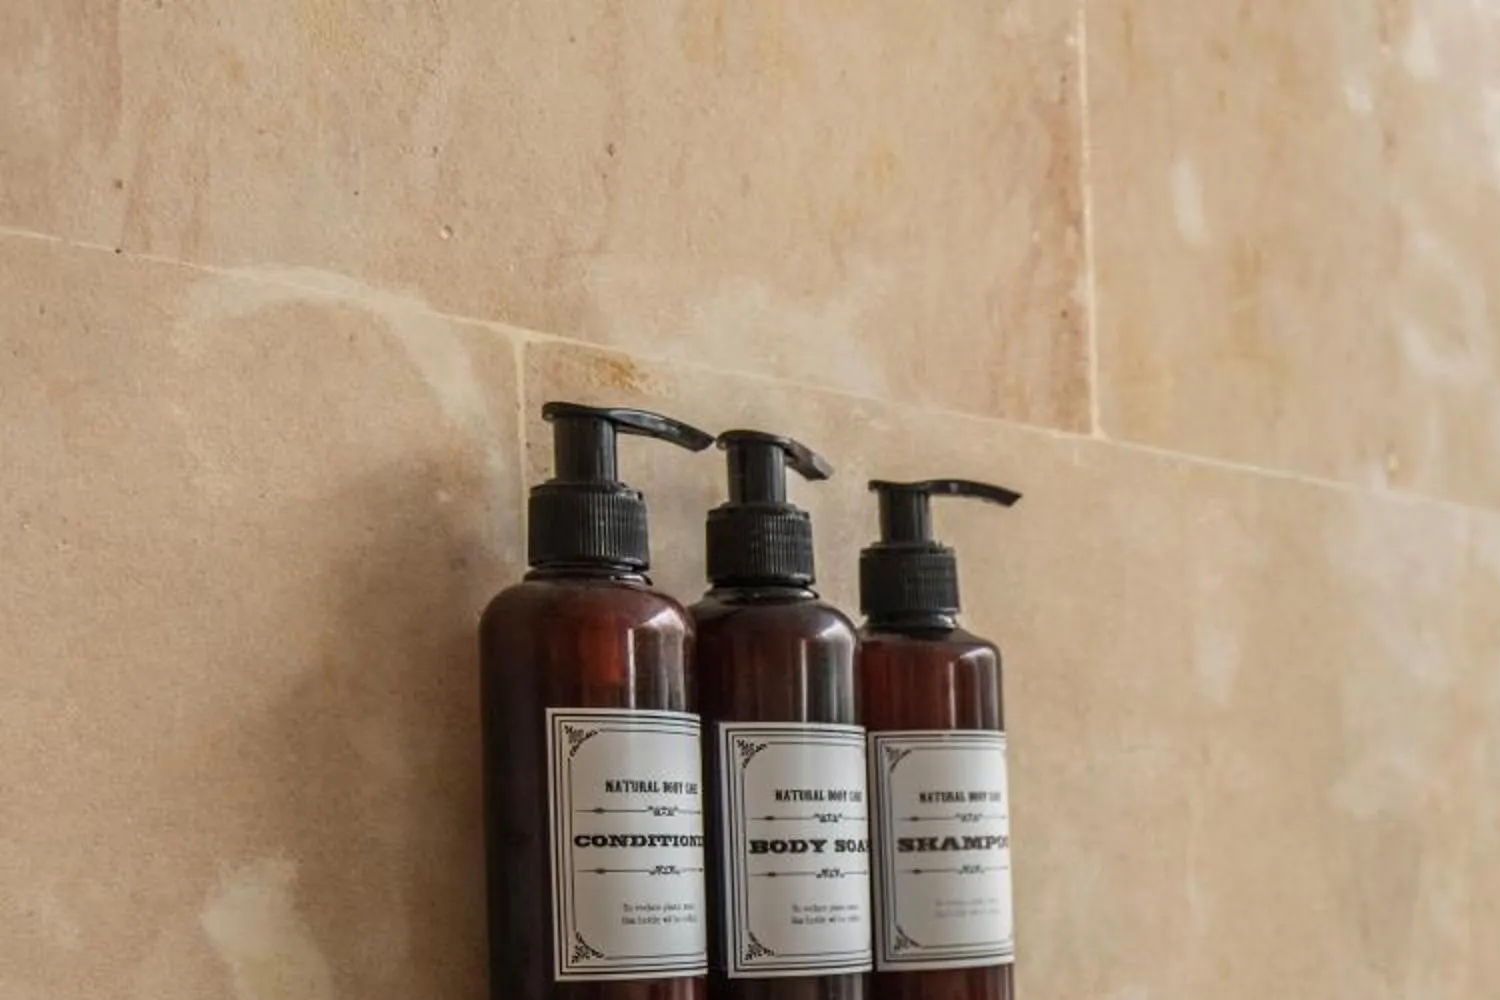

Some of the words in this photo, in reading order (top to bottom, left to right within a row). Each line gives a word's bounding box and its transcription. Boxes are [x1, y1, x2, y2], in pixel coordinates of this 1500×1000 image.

[605, 780, 660, 793] NATURAL
[776, 789, 824, 801] NATURAL
[749, 839, 828, 854] BODY
